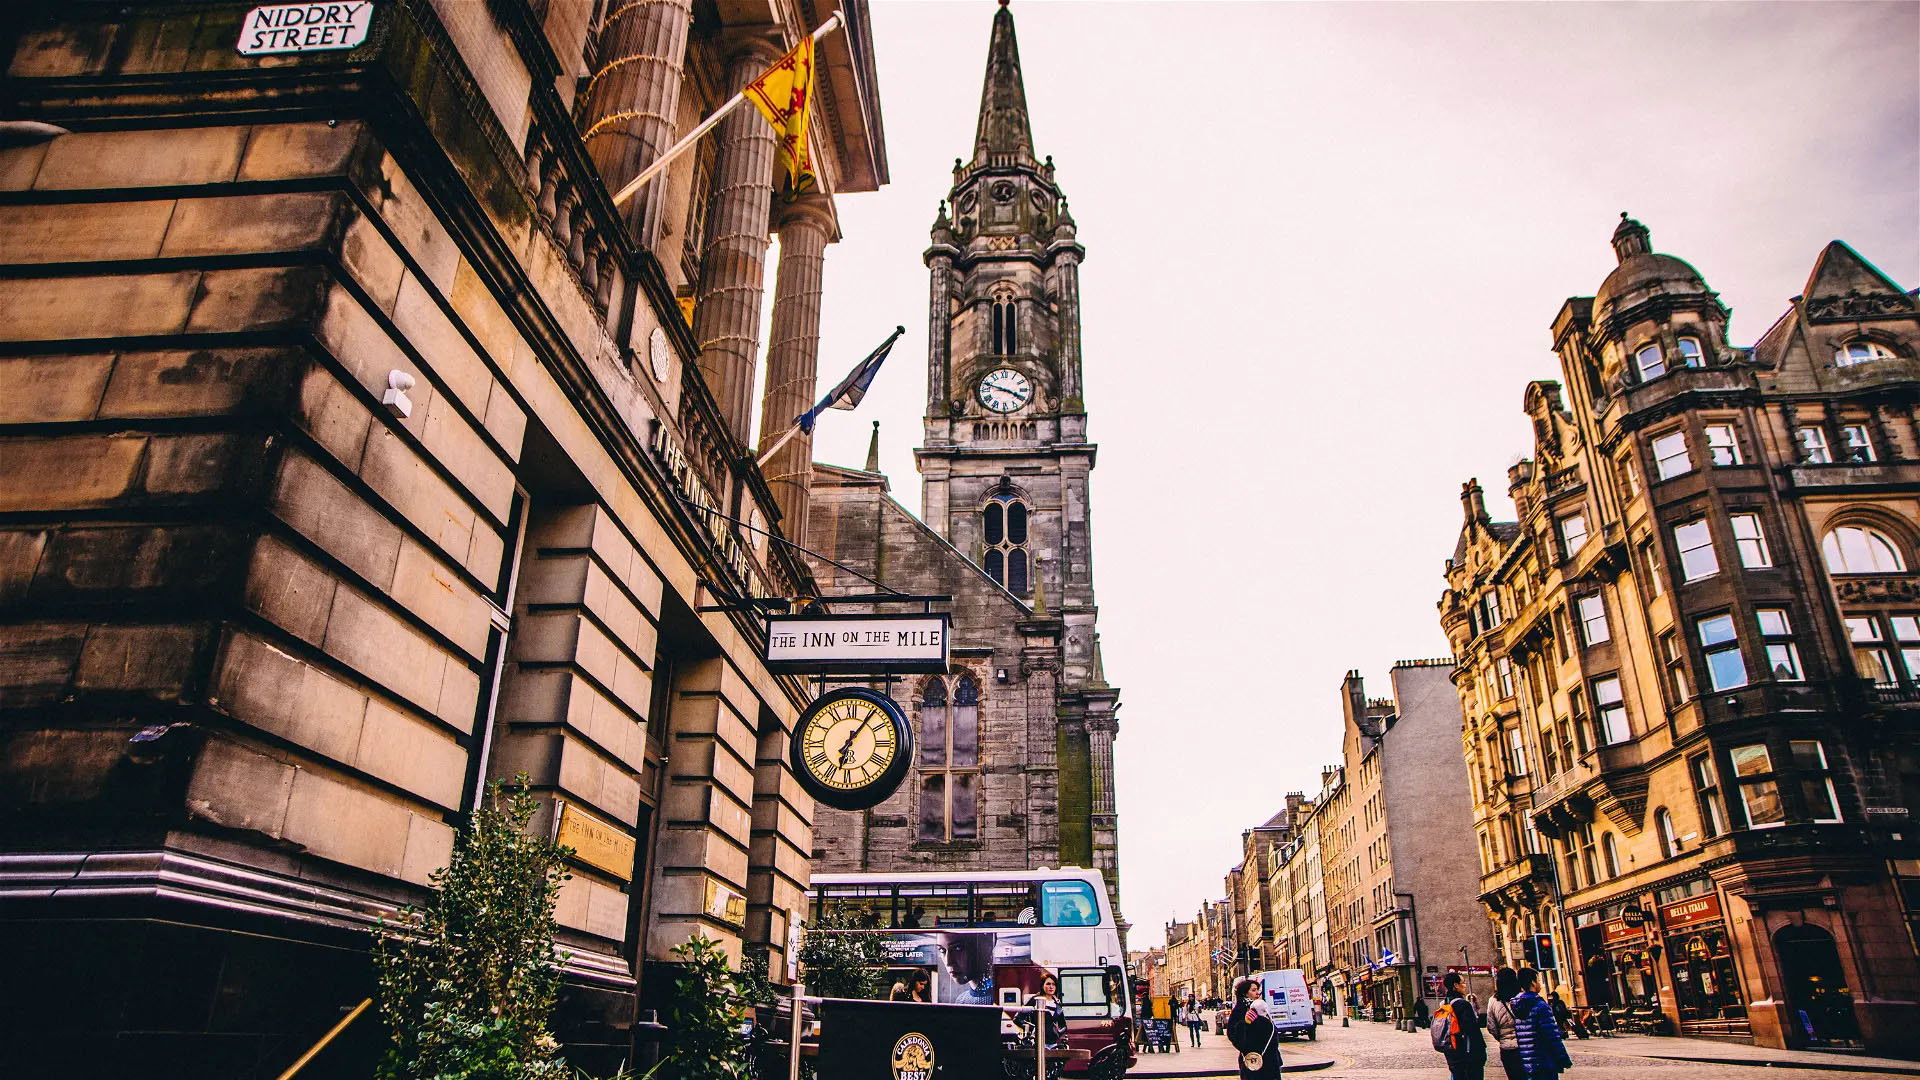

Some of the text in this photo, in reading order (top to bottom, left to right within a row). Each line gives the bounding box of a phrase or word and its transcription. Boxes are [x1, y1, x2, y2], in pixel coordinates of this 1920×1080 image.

[253, 4, 363, 28] NIDDRY
[250, 25, 355, 49] STREET
[772, 631, 940, 648] THE INN ON THE MILE
[582, 821, 594, 840] INN
[595, 829, 603, 841] ON
[614, 839, 629, 857] MILE
[1670, 901, 1709, 918] BELLA ITALIA
[896, 1036, 931, 1057] CALEDONIA
[900, 1071, 927, 1080] BEST
